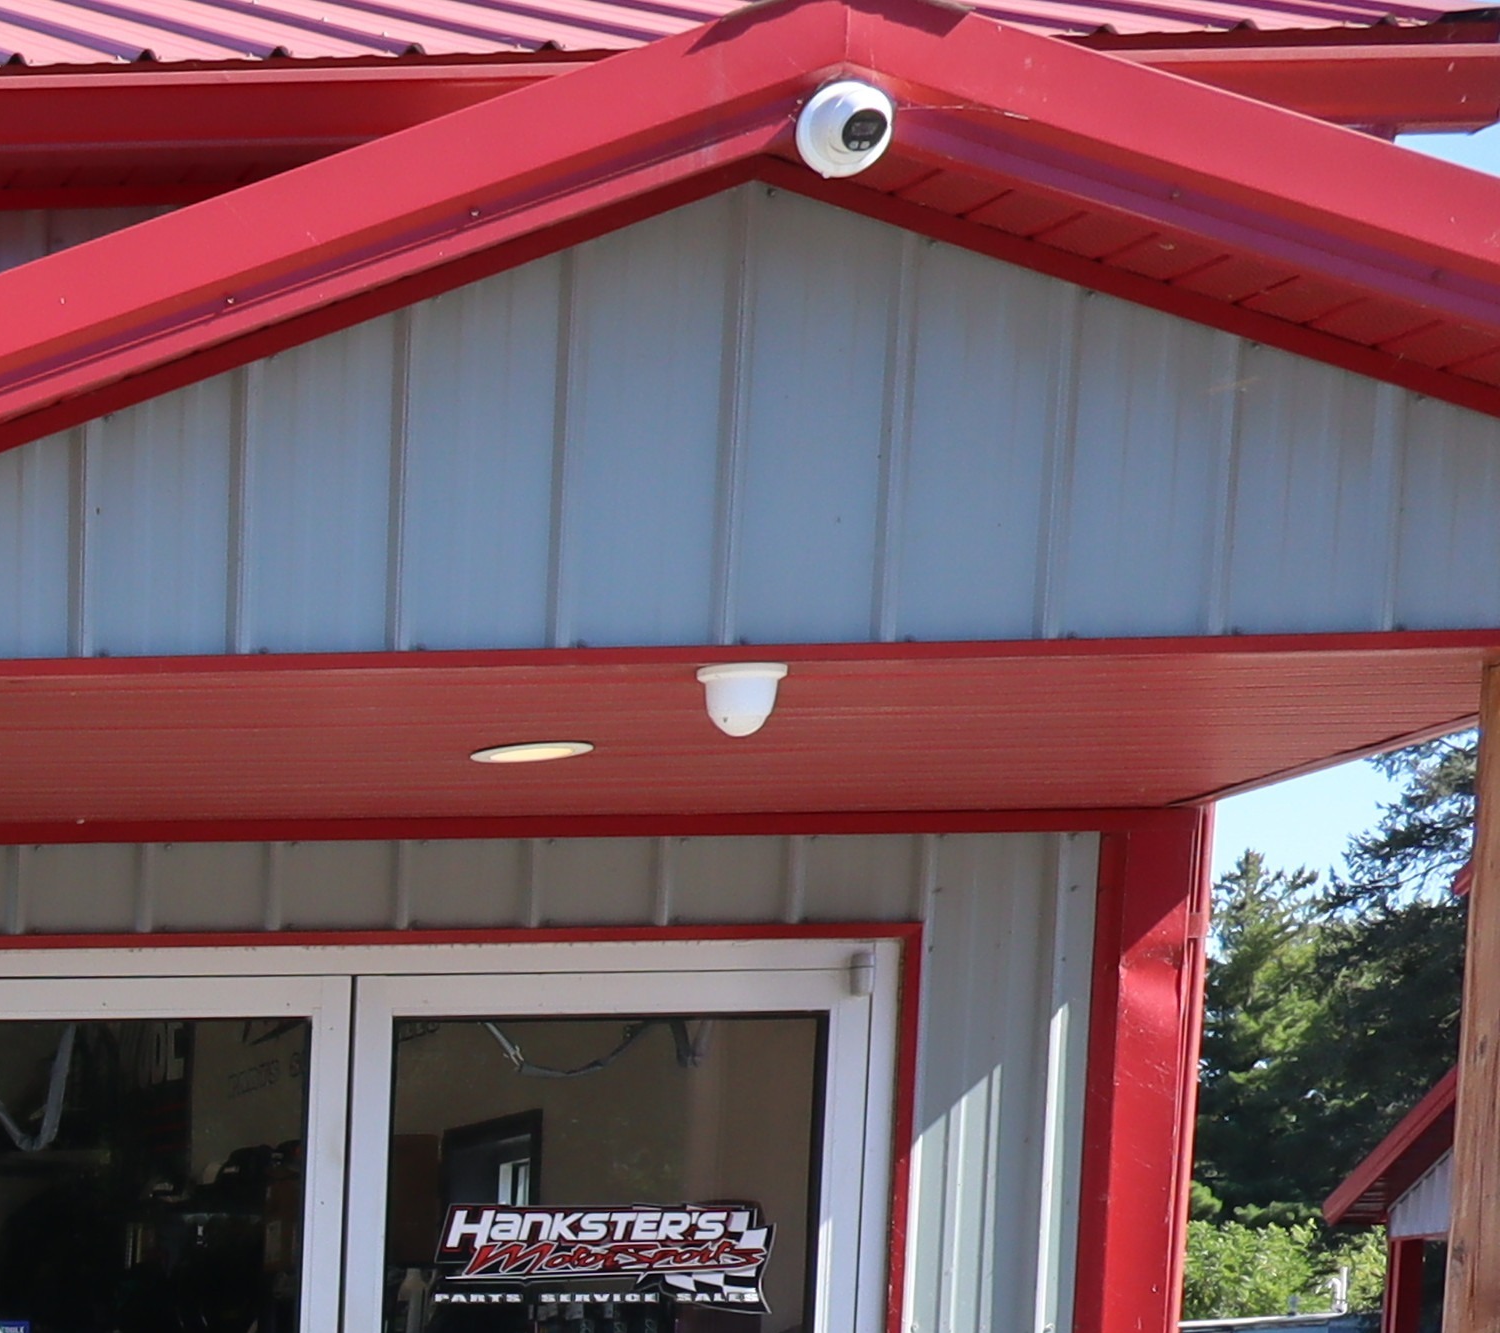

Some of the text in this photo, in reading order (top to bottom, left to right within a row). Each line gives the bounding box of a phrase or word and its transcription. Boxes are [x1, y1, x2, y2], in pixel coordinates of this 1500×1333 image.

[434, 1292, 759, 1303] PARTS SERVICE SALES
